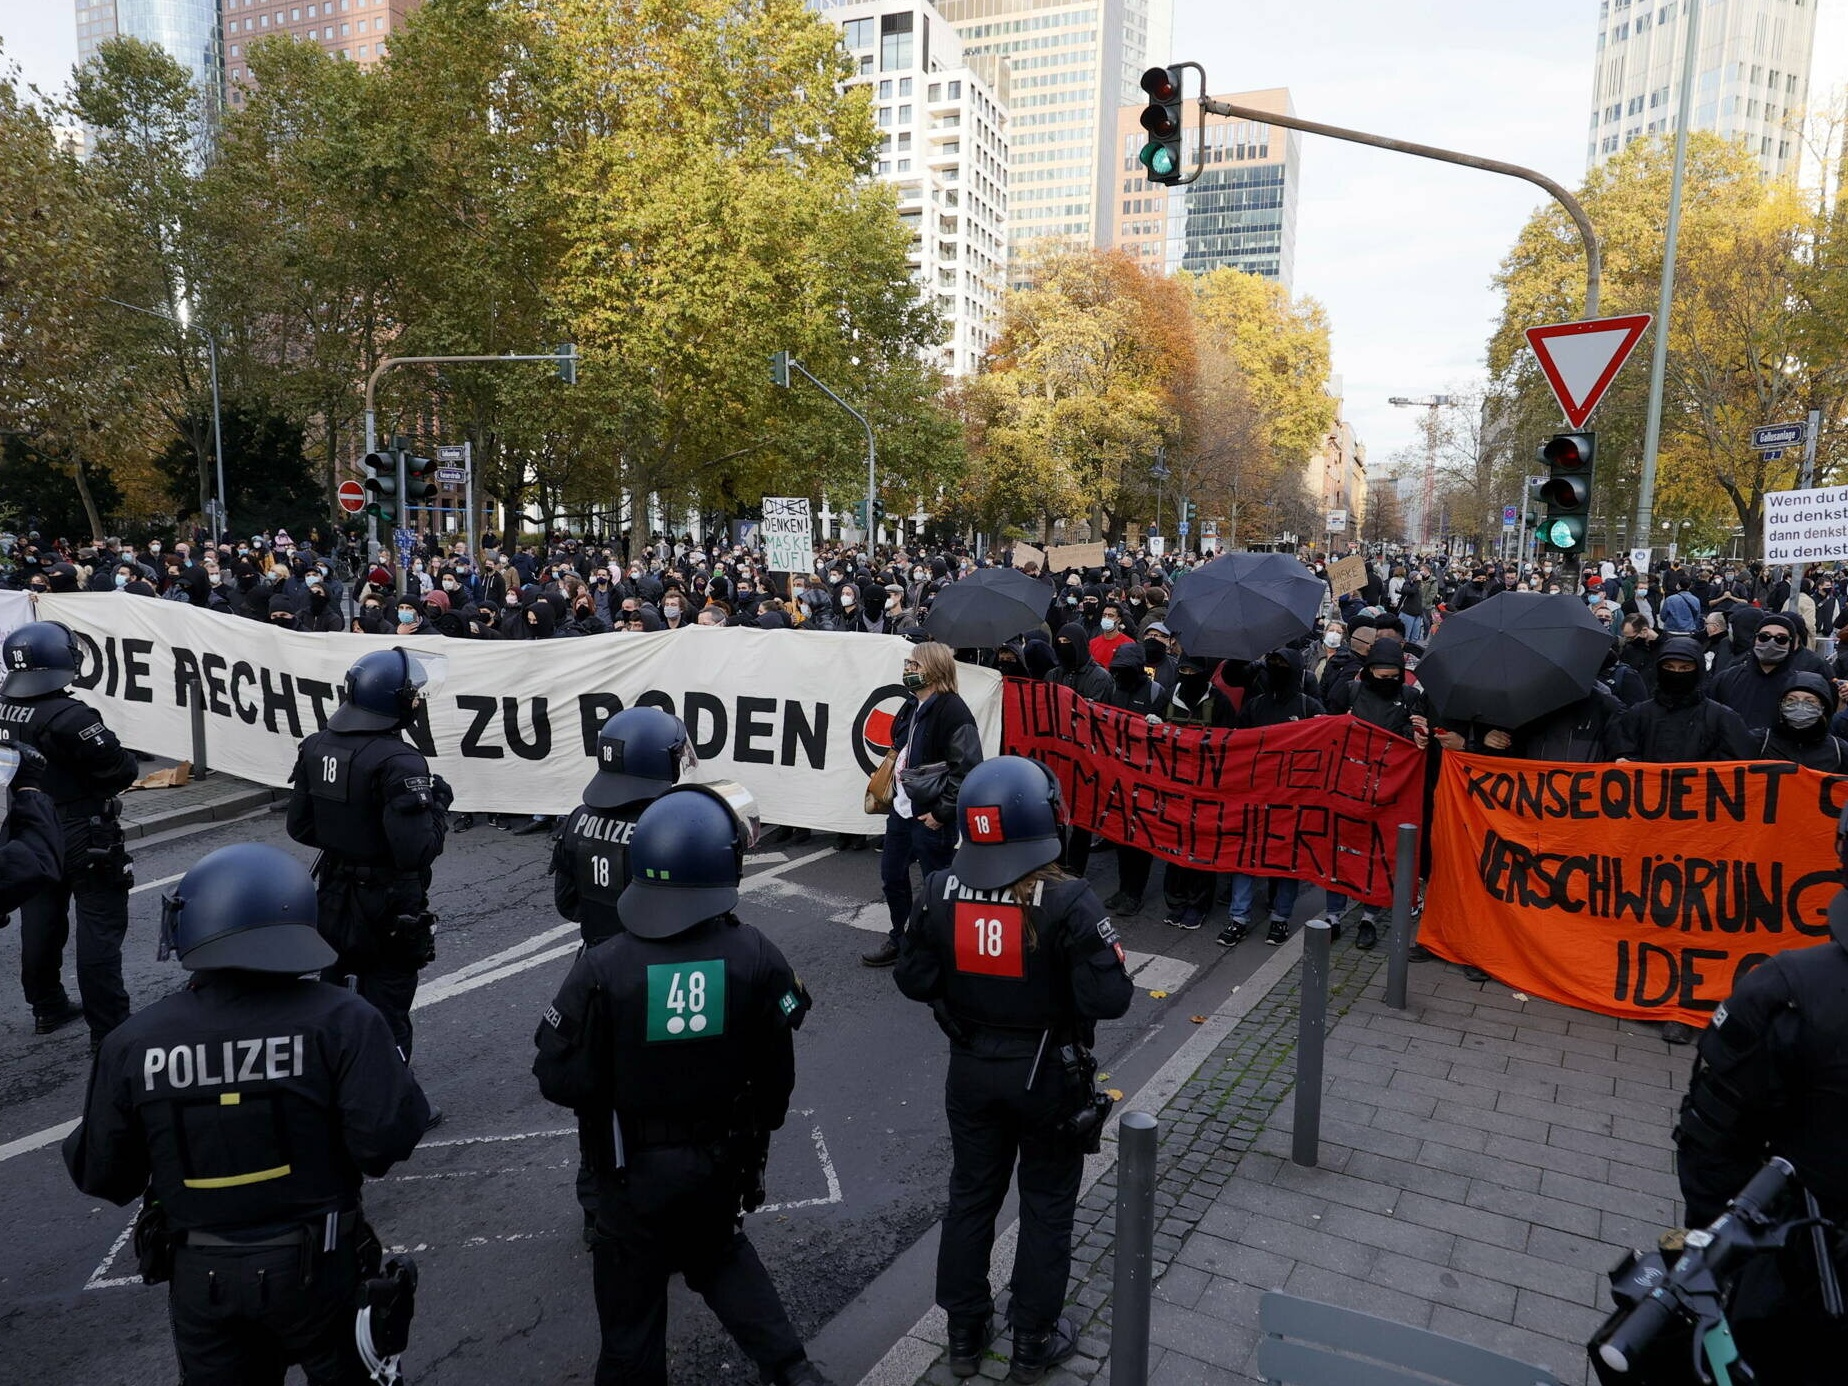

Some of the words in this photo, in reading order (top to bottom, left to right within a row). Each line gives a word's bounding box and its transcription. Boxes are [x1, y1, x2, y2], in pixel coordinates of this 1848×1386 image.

[1770, 495, 1811, 507] Wenn
[1816, 492, 1835, 504] du
[764, 517, 809, 534] DENKEN!
[1770, 513, 1789, 524] du
[1793, 507, 1848, 523] denkst
[766, 535, 810, 552] MASKE
[1769, 530, 1800, 542] dann
[1804, 526, 1847, 540] denkst
[1769, 547, 1788, 559] du
[1793, 543, 1848, 557] denkst
[771, 552, 806, 572] AUF!
[12, 650, 24, 663] 18
[72, 630, 153, 701] DIE
[172, 647, 437, 757] RECHTN
[456, 695, 552, 760] ZU
[579, 691, 829, 770] BDEN
[0, 703, 35, 723] LIZEI
[1007, 678, 1229, 788] TOLERIEREN
[602, 745, 613, 762] 18
[322, 755, 337, 784] 18
[1464, 763, 1798, 824] KONSEQUENT
[574, 813, 636, 845] POLIZE
[974, 815, 990, 834] 18
[591, 855, 609, 888] 18
[975, 918, 1003, 957] 18
[666, 971, 706, 1014] 48
[143, 1034, 304, 1092] POLIZEI
